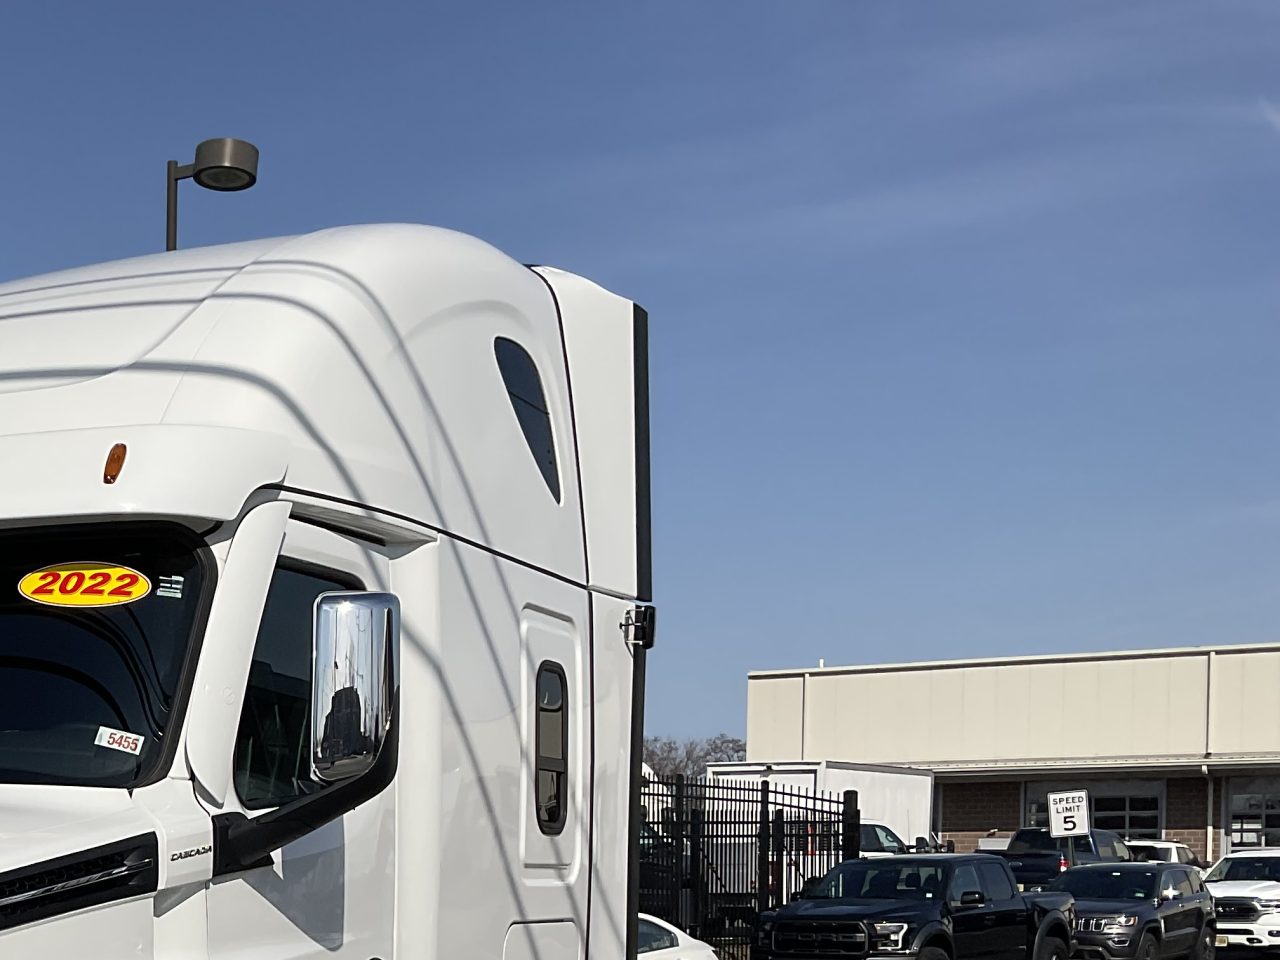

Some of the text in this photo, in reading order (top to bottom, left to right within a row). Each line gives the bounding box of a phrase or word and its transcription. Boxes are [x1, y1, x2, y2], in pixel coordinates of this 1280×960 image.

[31, 571, 139, 597] 2022
[107, 732, 140, 752] 5455
[1052, 796, 1084, 805] SPEED
[1056, 805, 1081, 814] LIMIT
[1063, 815, 1077, 832] 5
